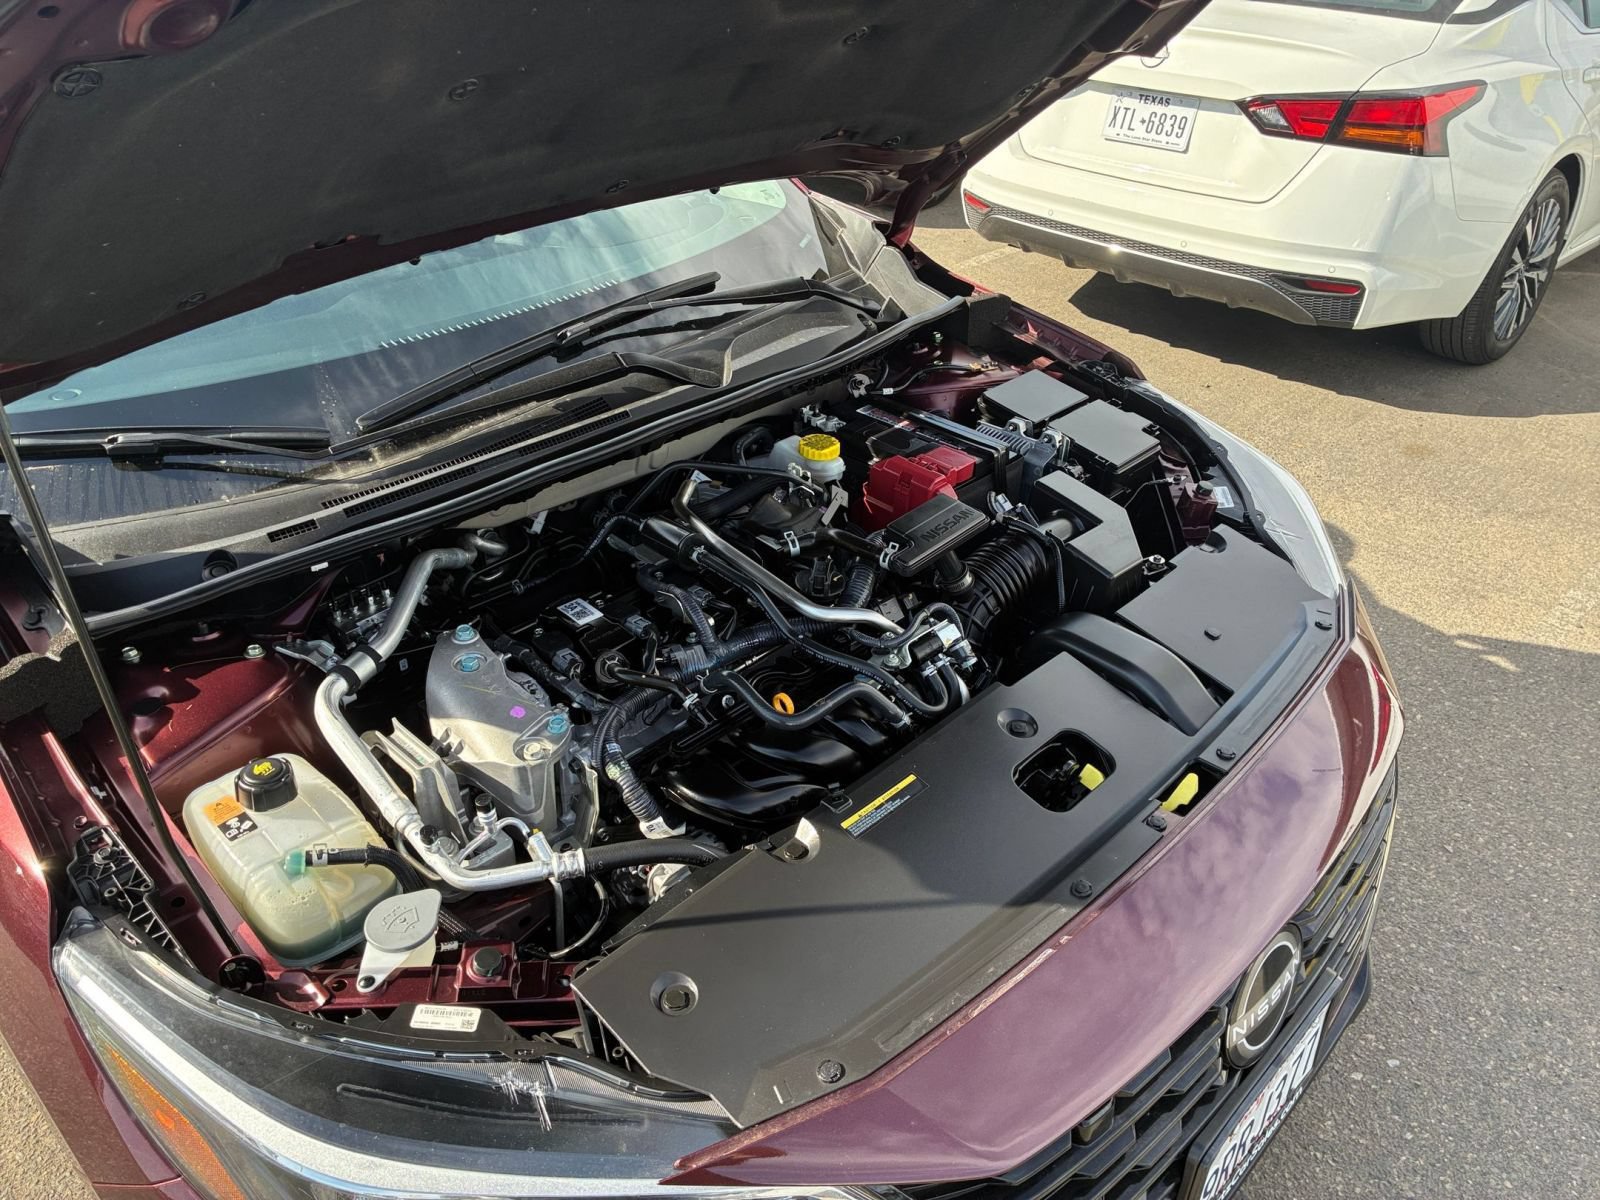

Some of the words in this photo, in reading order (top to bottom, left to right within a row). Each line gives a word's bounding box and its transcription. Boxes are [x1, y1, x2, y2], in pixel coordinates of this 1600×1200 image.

[1138, 93, 1171, 107] TEXAS
[920, 508, 975, 542] NISSAN
[1233, 948, 1300, 1042] NISSAN
